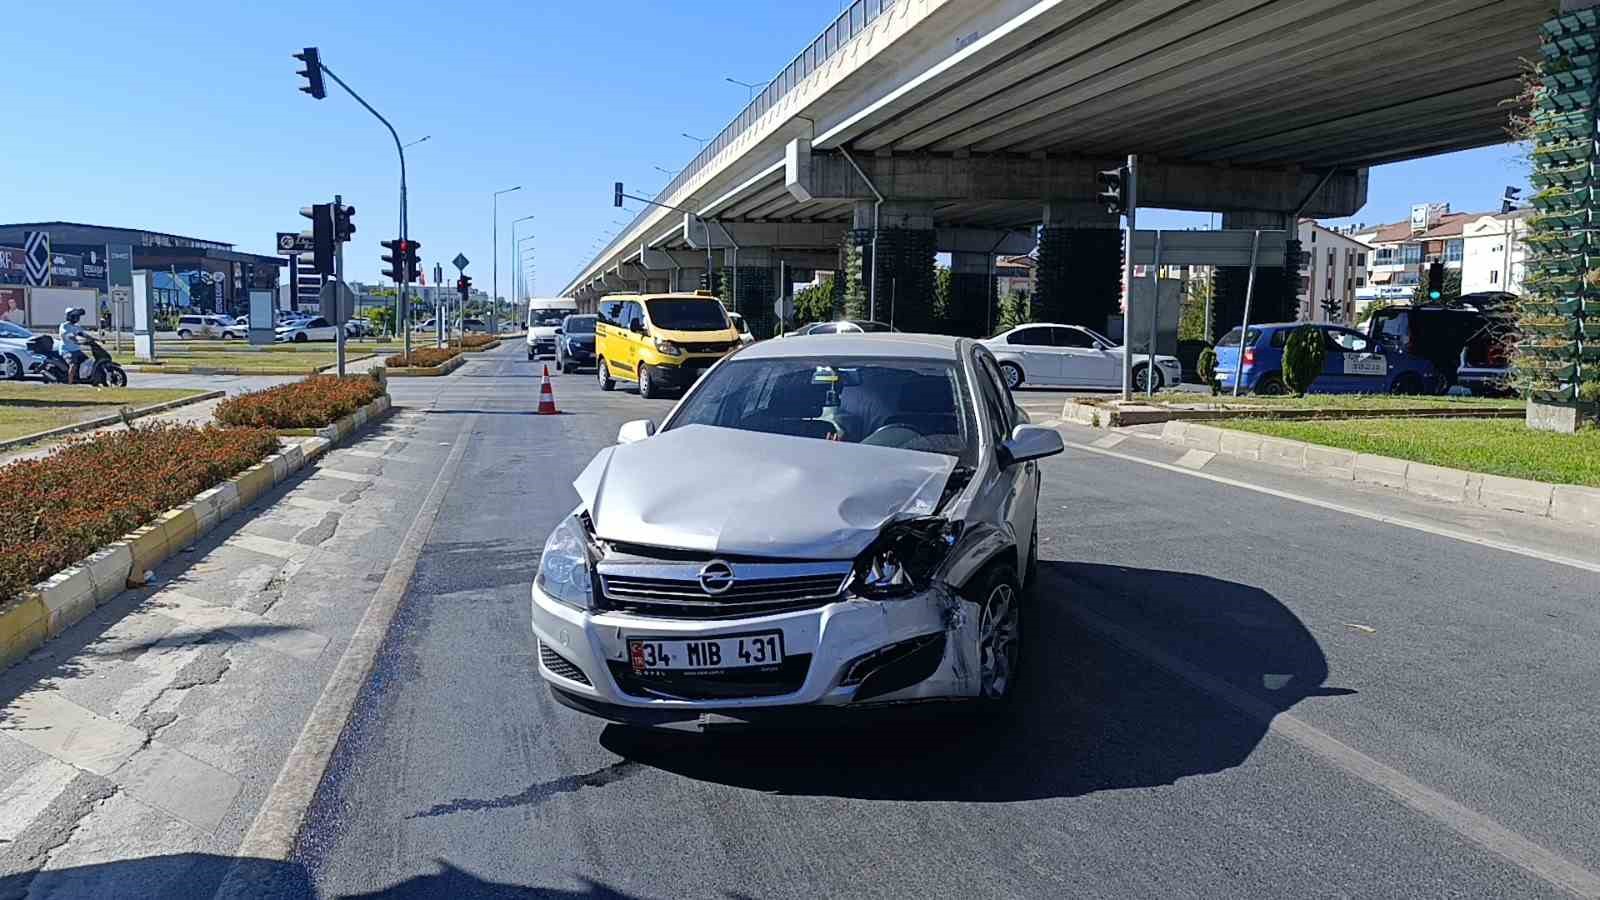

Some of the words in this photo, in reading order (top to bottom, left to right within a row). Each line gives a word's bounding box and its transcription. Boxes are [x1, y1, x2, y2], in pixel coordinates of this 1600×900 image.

[644, 643, 670, 666] 34
[687, 641, 721, 666] MIB
[738, 637, 777, 663] 431
